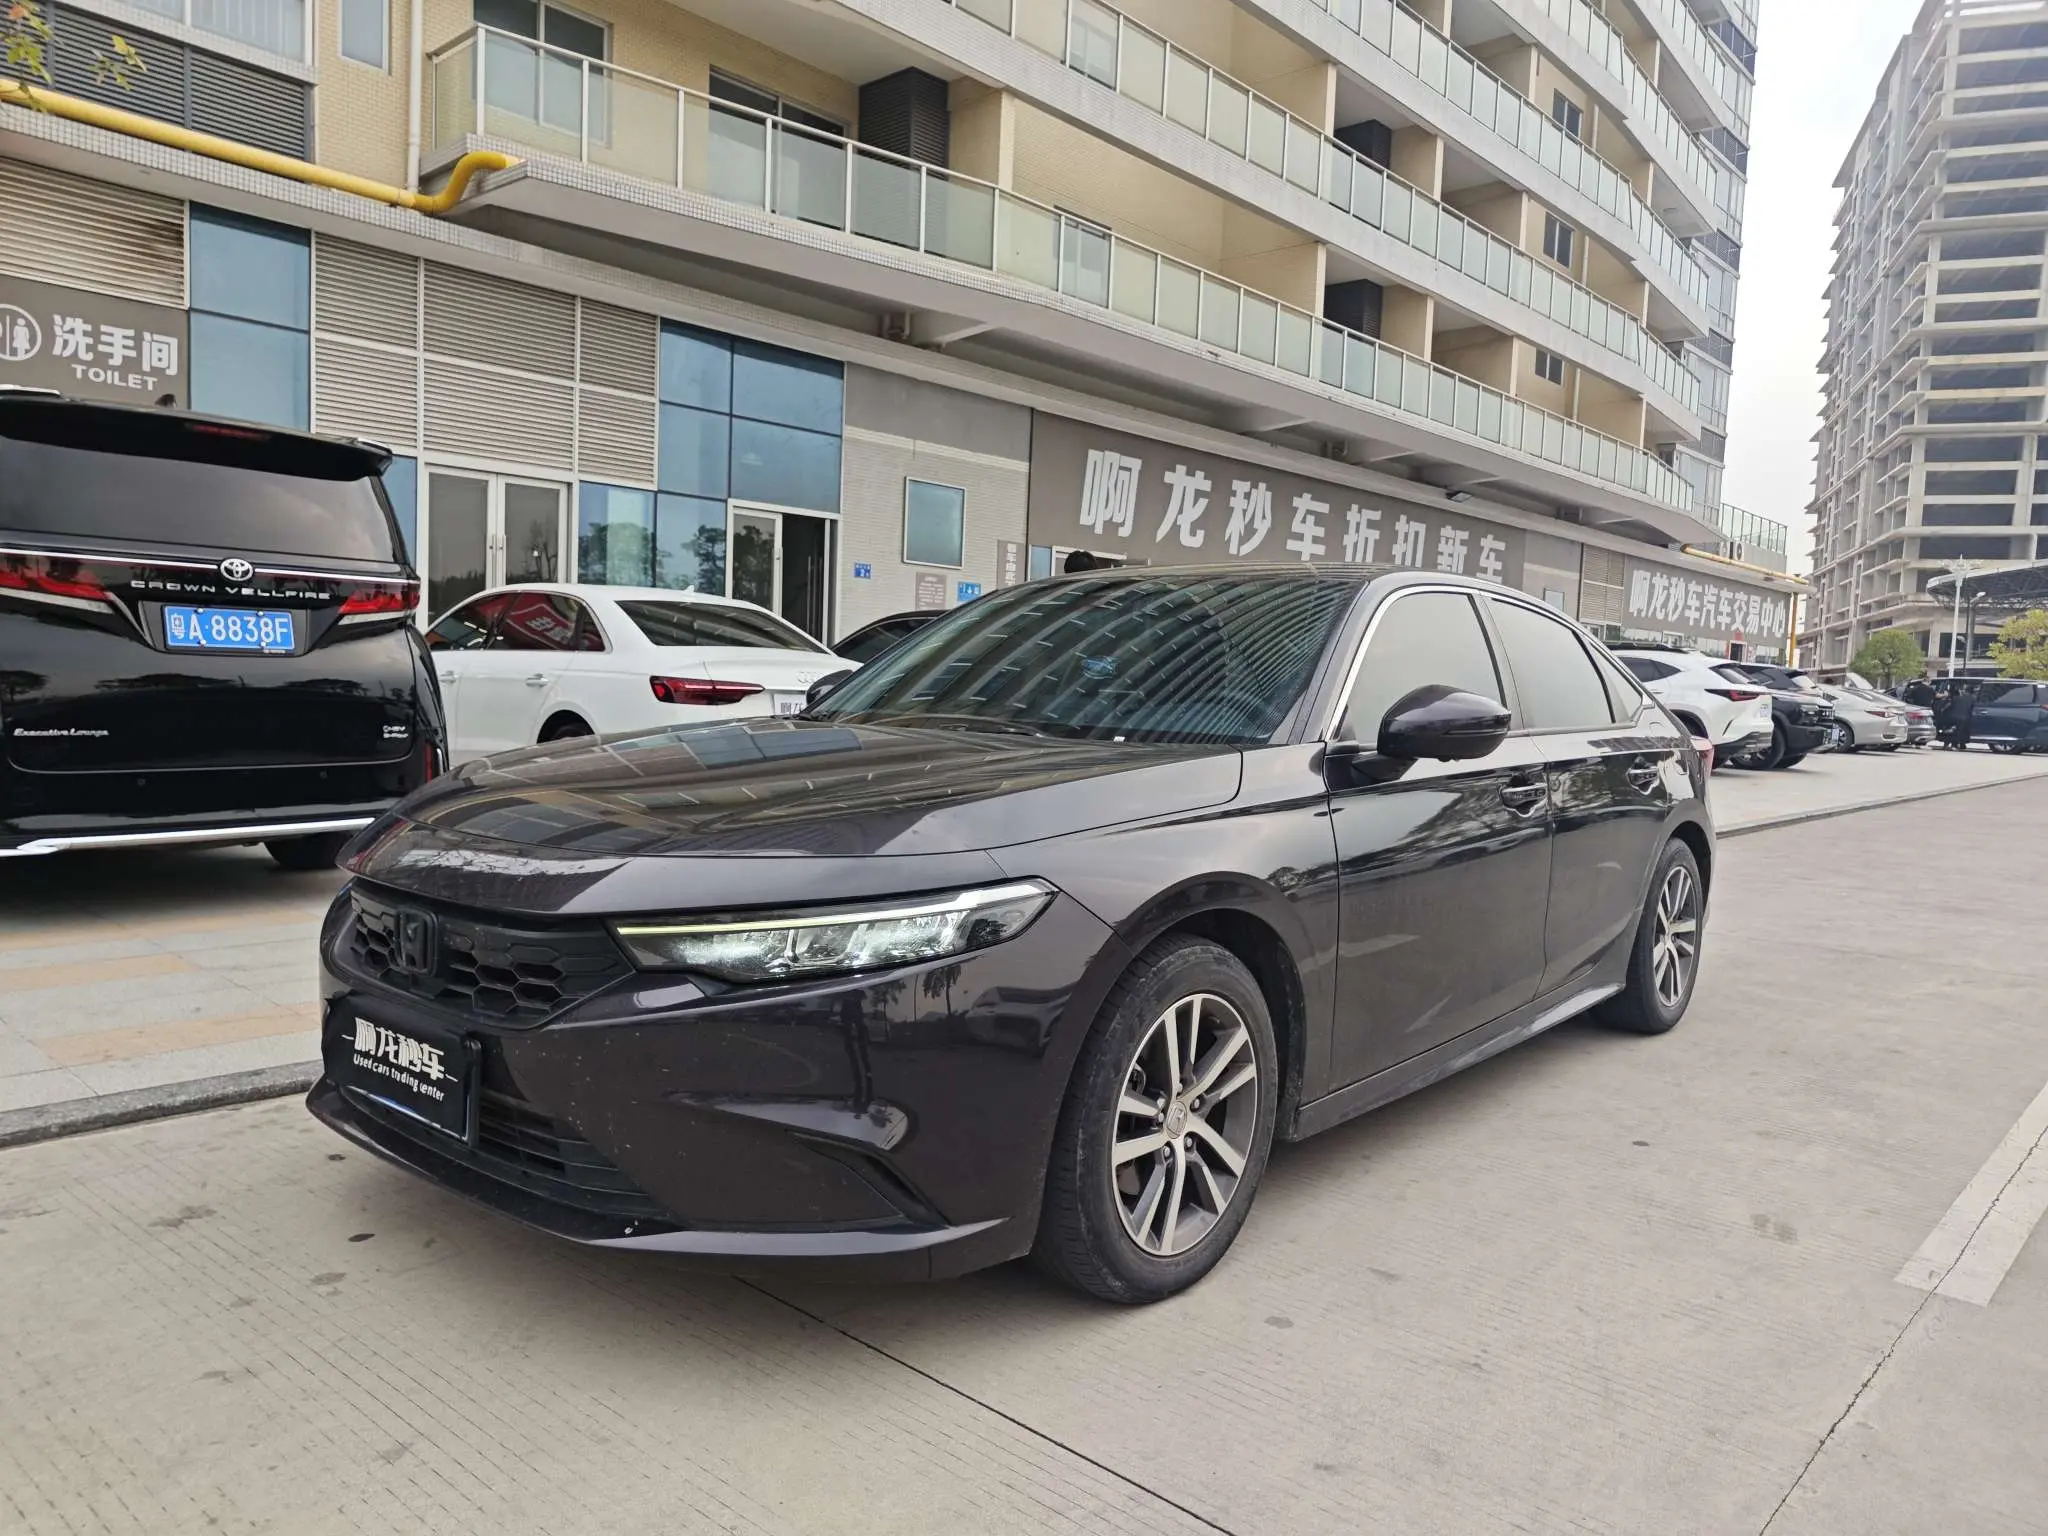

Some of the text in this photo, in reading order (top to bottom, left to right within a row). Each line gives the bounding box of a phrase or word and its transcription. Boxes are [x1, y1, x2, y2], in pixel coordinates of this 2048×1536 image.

[52, 314, 178, 376] 洗手间
[71, 364, 158, 391] TOILET
[1080, 449, 1506, 584] 啊龙秒车折扣新车
[130, 580, 330, 600] CROWN VELLFIRE
[1629, 570, 1786, 638] 啊龙秒车汽车交易中心
[353, 1053, 373, 1070] Used
[372, 1061, 390, 1077] cars
[354, 1016, 445, 1080] 啊龙秒车
